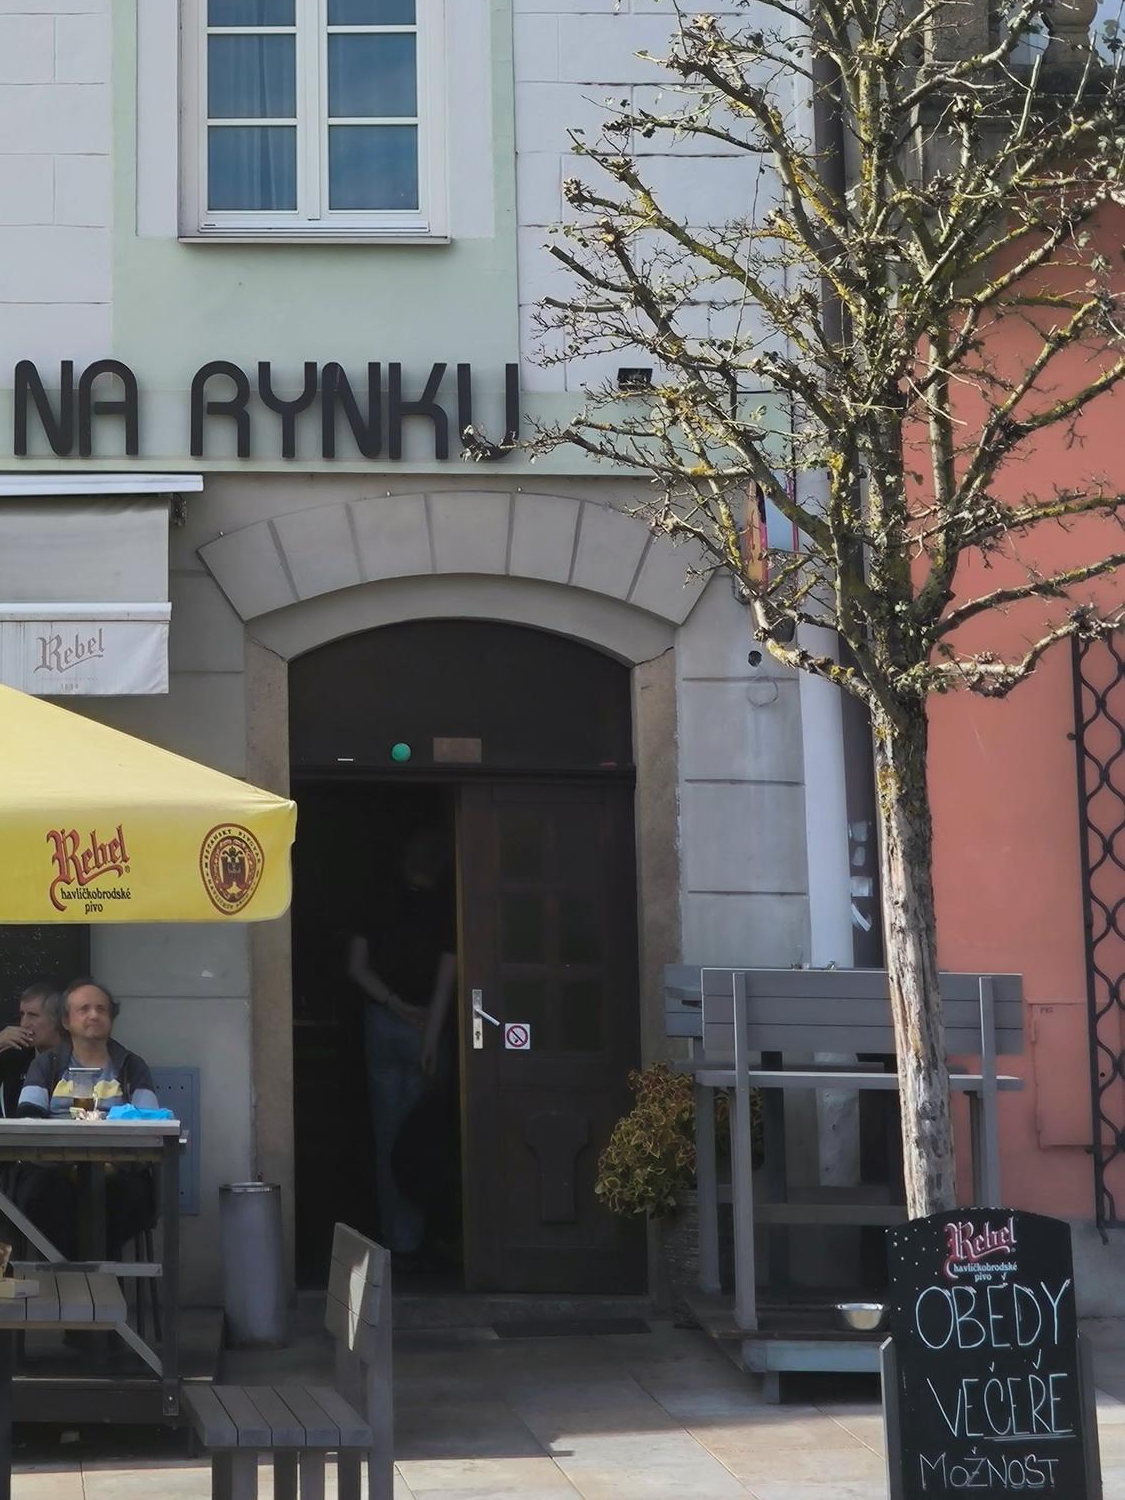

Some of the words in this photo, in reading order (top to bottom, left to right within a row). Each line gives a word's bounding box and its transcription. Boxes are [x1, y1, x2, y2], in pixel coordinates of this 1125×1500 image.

[14, 358, 139, 457] NA
[190, 360, 520, 460] RYNKU
[33, 627, 107, 673] Rebel
[46, 824, 131, 912] Rebel
[85, 901, 104, 915] pivo
[943, 1216, 1018, 1279] Rebel
[974, 1273, 993, 1283] pivo
[915, 1272, 1071, 1350] OBĚDY
[926, 1348, 1074, 1438] VEČEŘE
